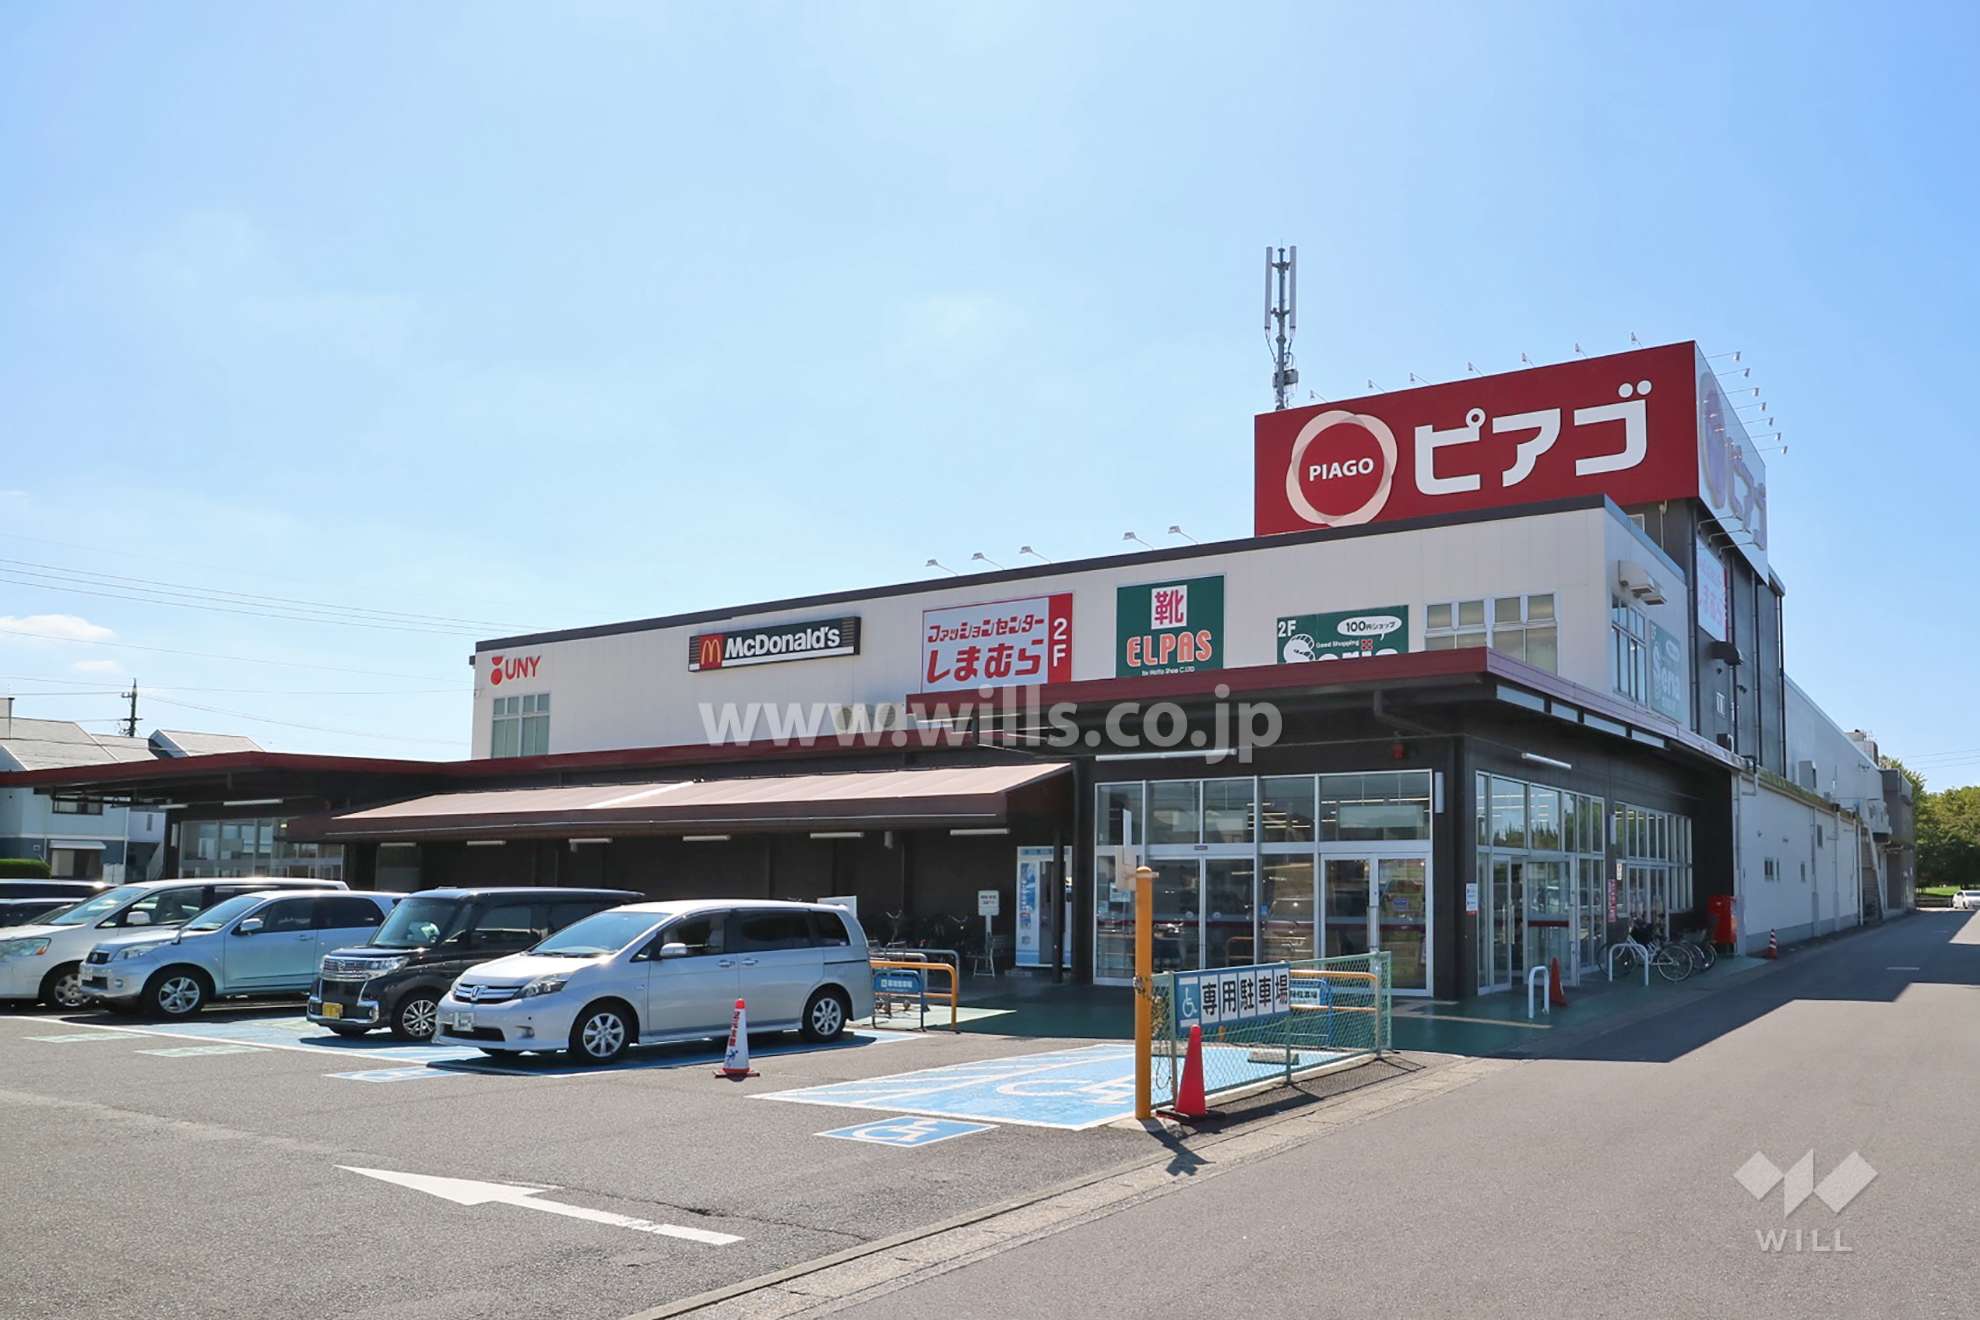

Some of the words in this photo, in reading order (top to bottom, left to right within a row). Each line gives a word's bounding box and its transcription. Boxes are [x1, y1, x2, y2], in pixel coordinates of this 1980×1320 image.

[1414, 380, 1653, 496] ピアゴ
[1308, 457, 1374, 482] PIAGO
[1154, 590, 1184, 624] 靴
[725, 626, 841, 659] McDonald's
[927, 614, 1045, 643] ファッションセンター
[1278, 620, 1296, 637] 2F
[926, 638, 1045, 683] しまむら
[1126, 629, 1213, 667] ELPAS
[505, 655, 541, 680] UNY
[1202, 974, 1288, 1016] 専用駐車場
